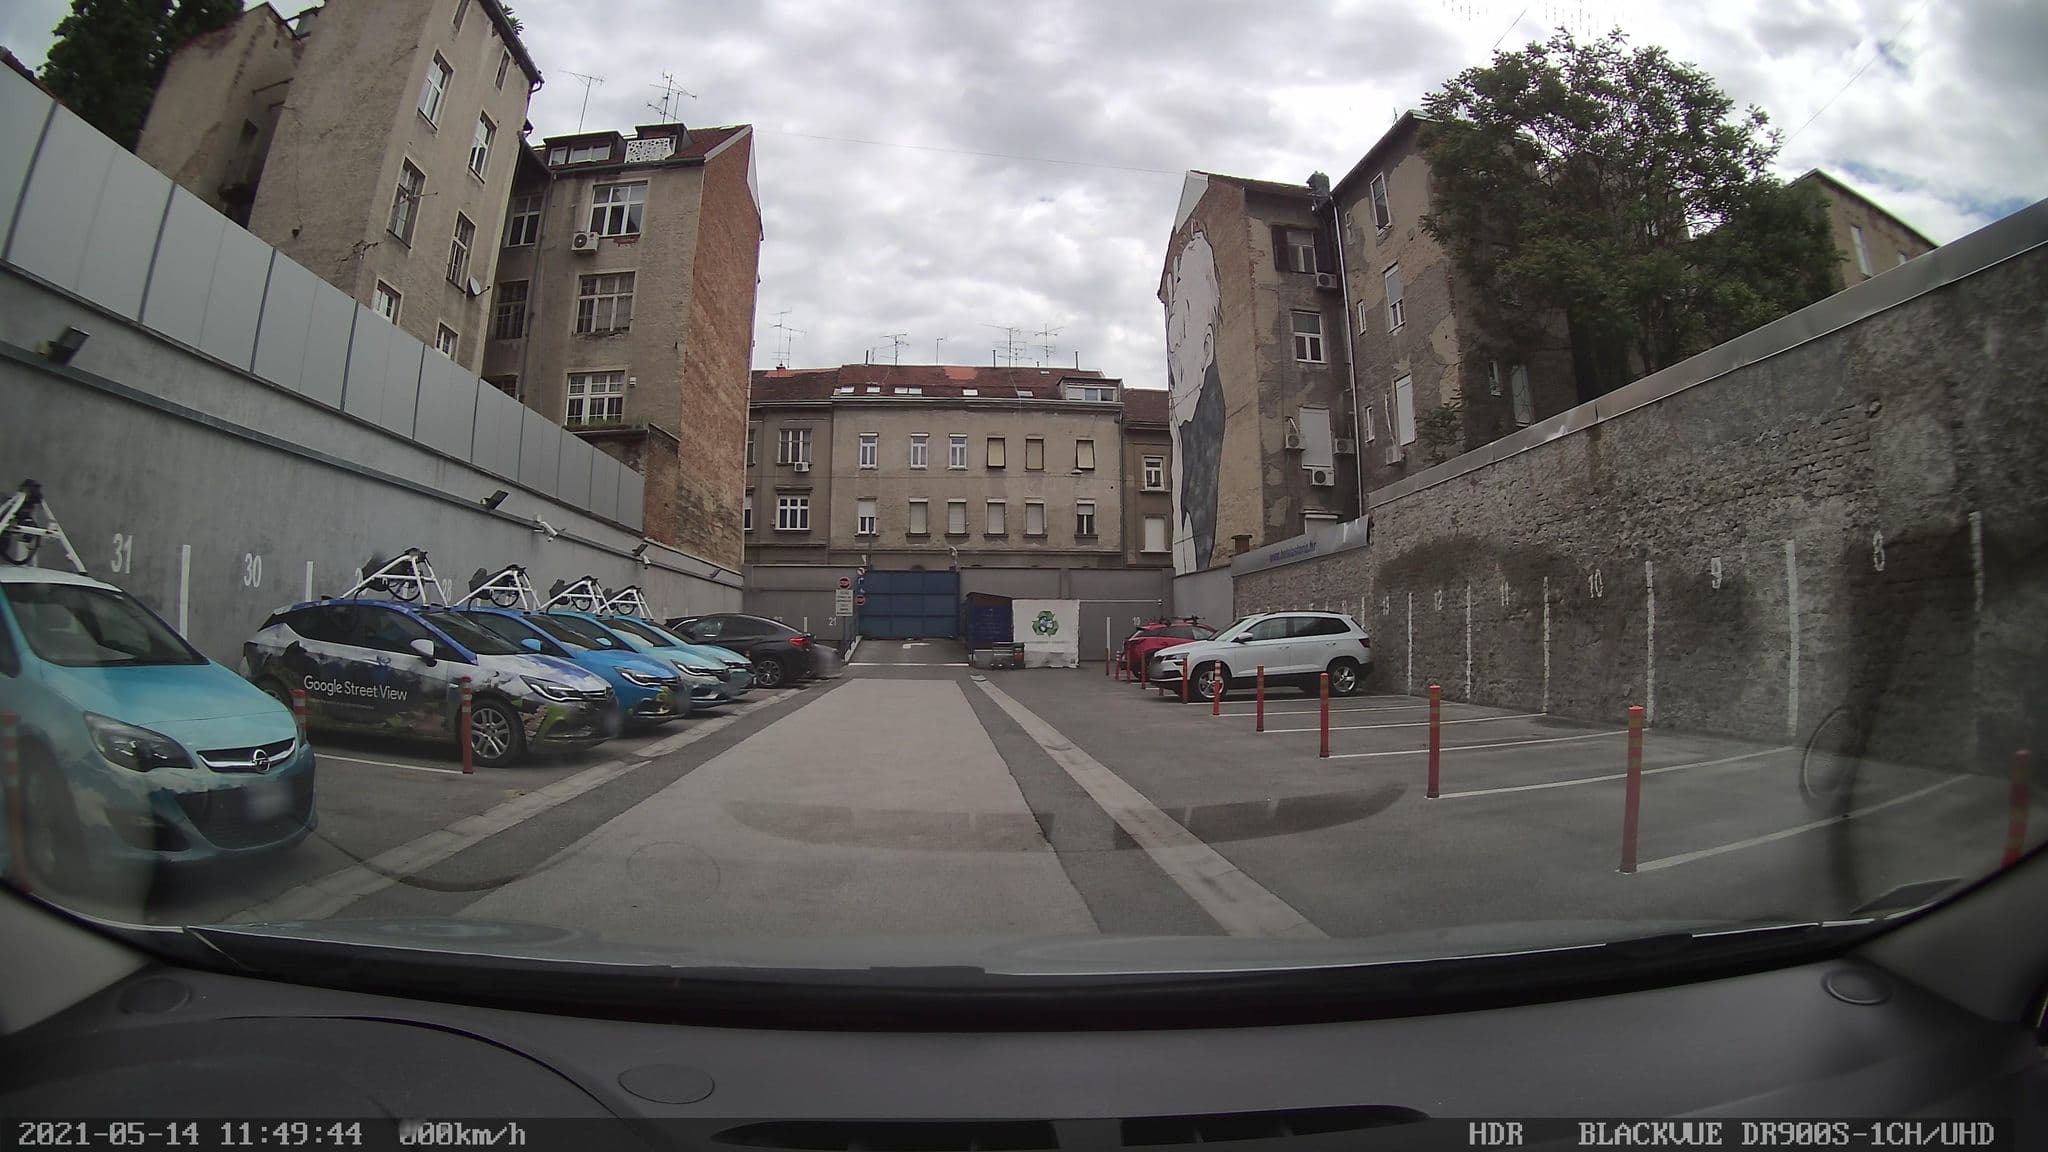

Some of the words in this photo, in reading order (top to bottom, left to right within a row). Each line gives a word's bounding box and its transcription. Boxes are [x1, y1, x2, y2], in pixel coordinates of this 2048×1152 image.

[111, 533, 132, 574] 31
[244, 553, 262, 587] 30
[1588, 568, 1603, 598] 10
[1711, 557, 1722, 589] 9
[304, 675, 343, 696] Google
[344, 681, 378, 698] Street
[379, 685, 408, 701] View
